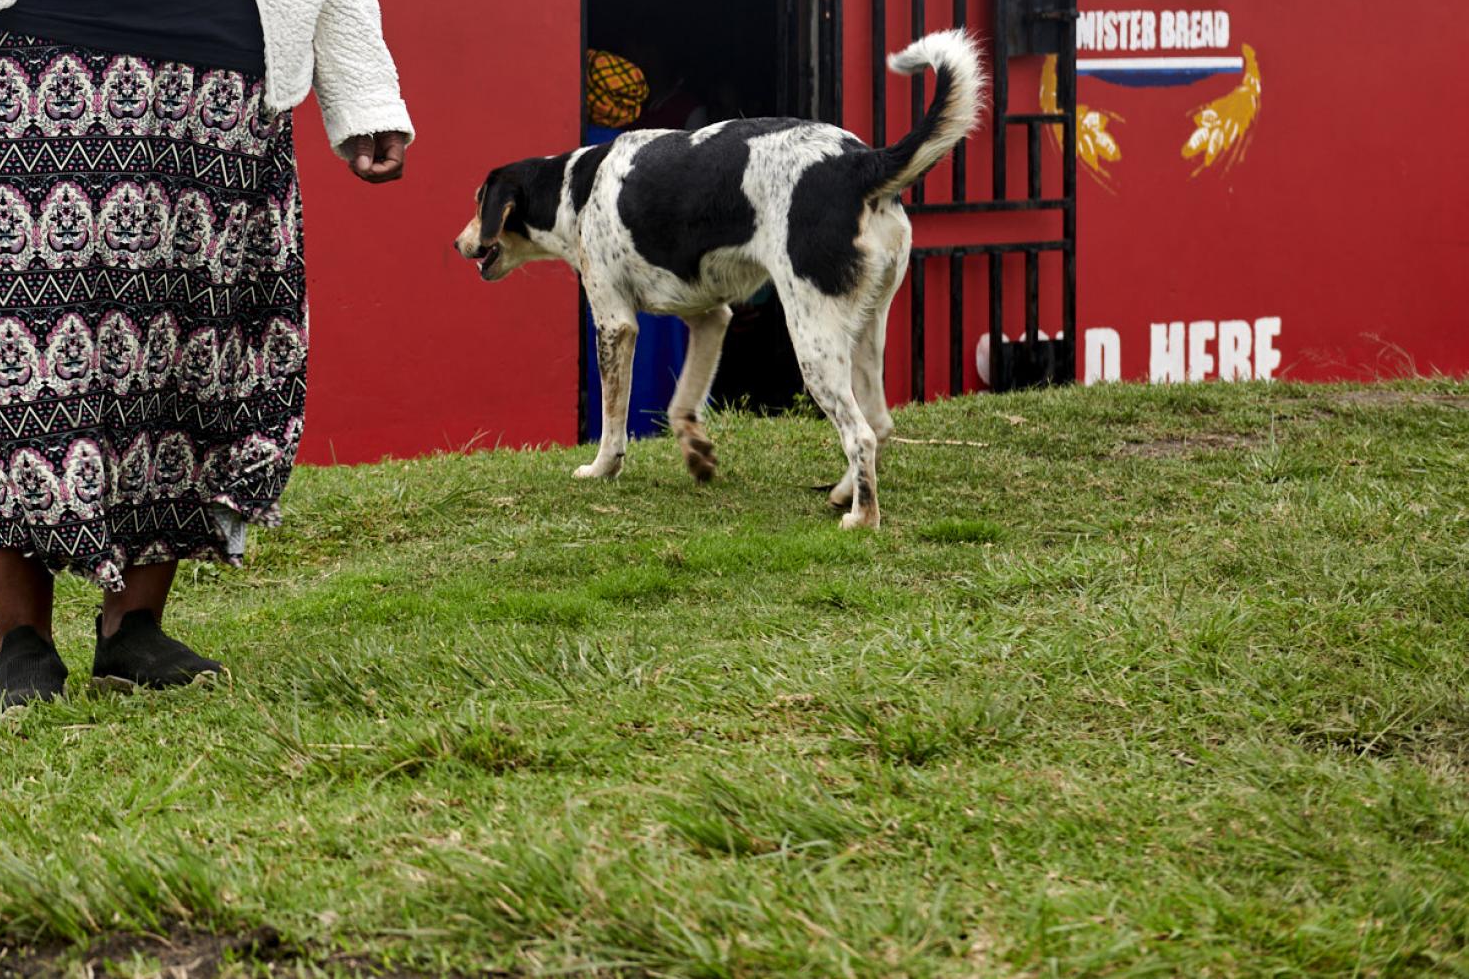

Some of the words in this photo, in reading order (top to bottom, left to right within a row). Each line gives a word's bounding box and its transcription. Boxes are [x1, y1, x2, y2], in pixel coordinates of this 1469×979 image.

[1075, 9, 1157, 52] MISTER
[1160, 9, 1230, 50] BREAD
[1150, 316, 1282, 386] HERE
